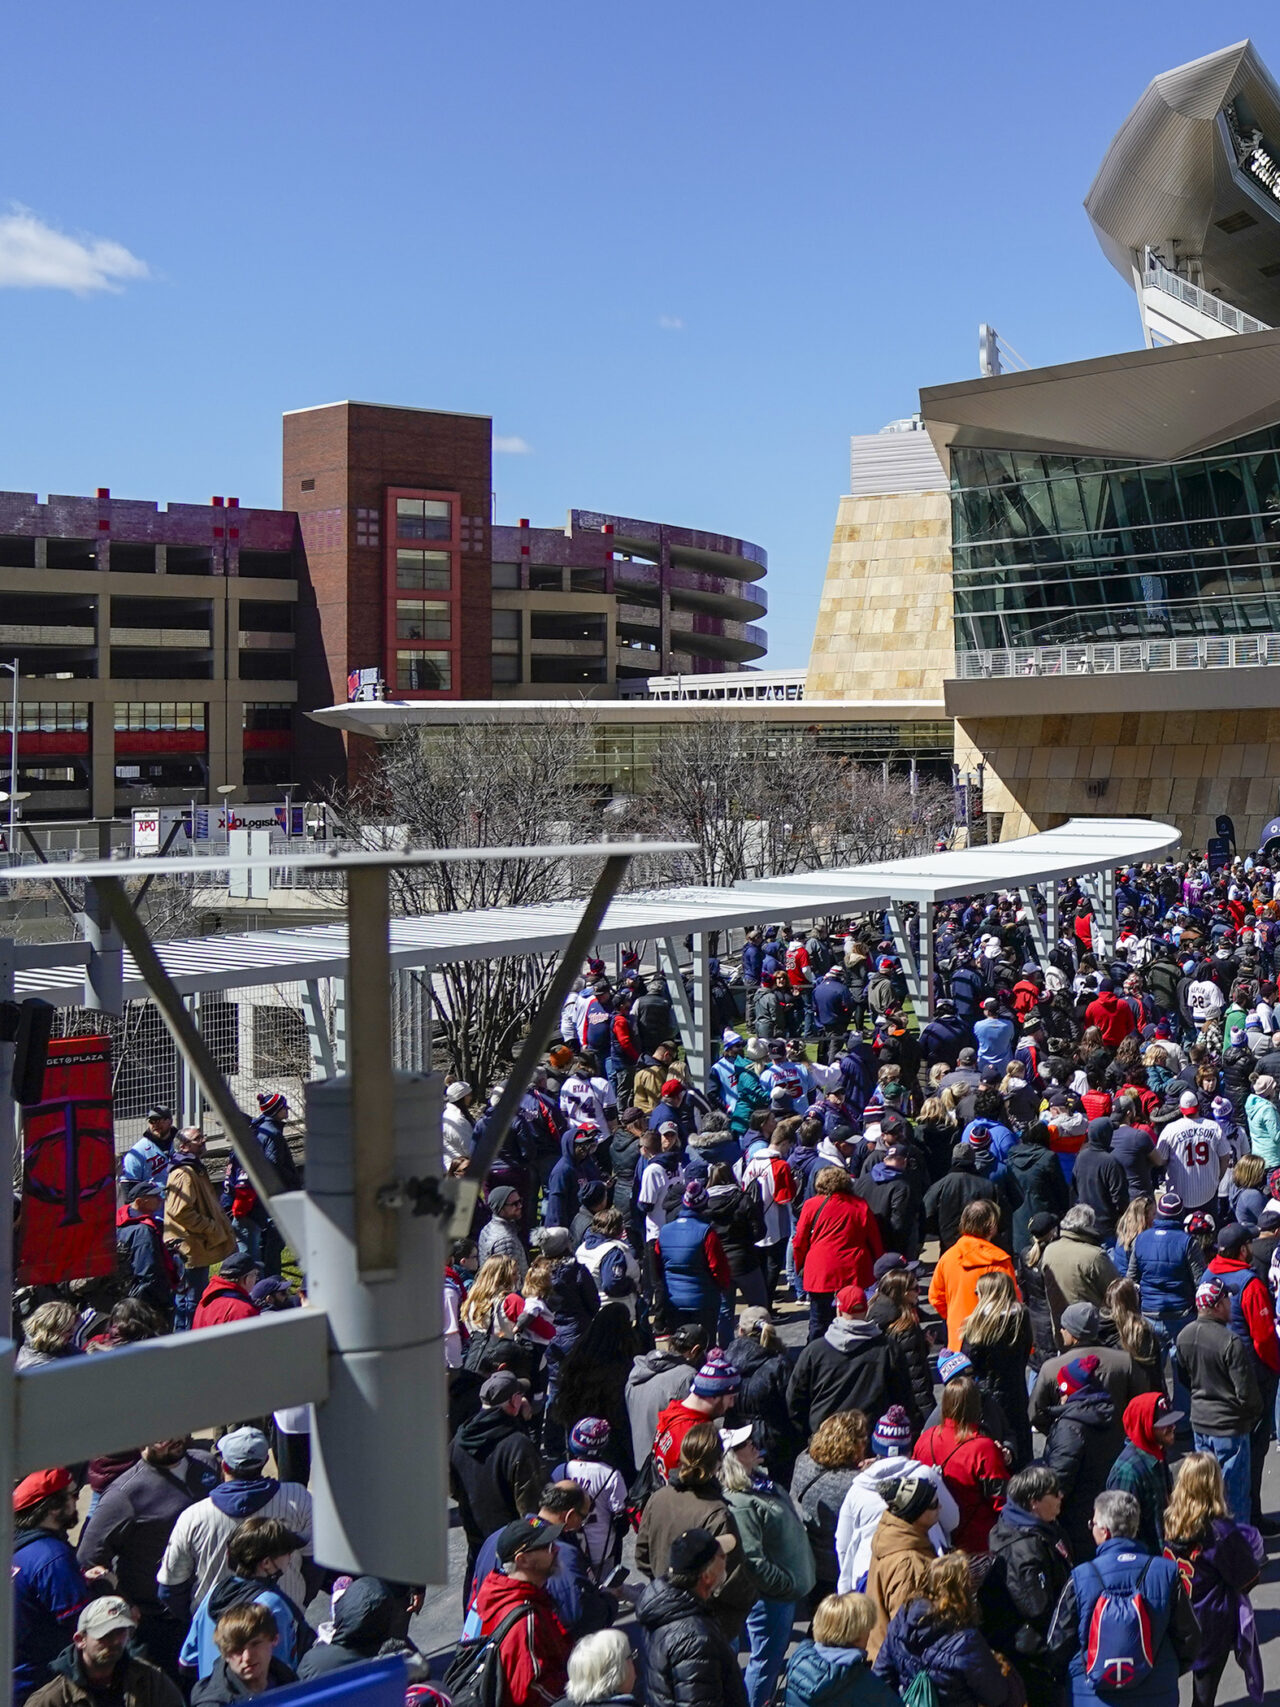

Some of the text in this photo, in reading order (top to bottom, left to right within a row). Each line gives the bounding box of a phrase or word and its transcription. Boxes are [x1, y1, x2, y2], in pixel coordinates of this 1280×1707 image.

[138, 821, 156, 832] XPO
[218, 818, 242, 829] XO
[73, 1053, 104, 1062] PLAZA
[567, 1096, 595, 1119] 74
[1177, 1129, 1216, 1143] ERICKSON
[1185, 1141, 1210, 1168] 19
[878, 1424, 910, 1436] TWINS
